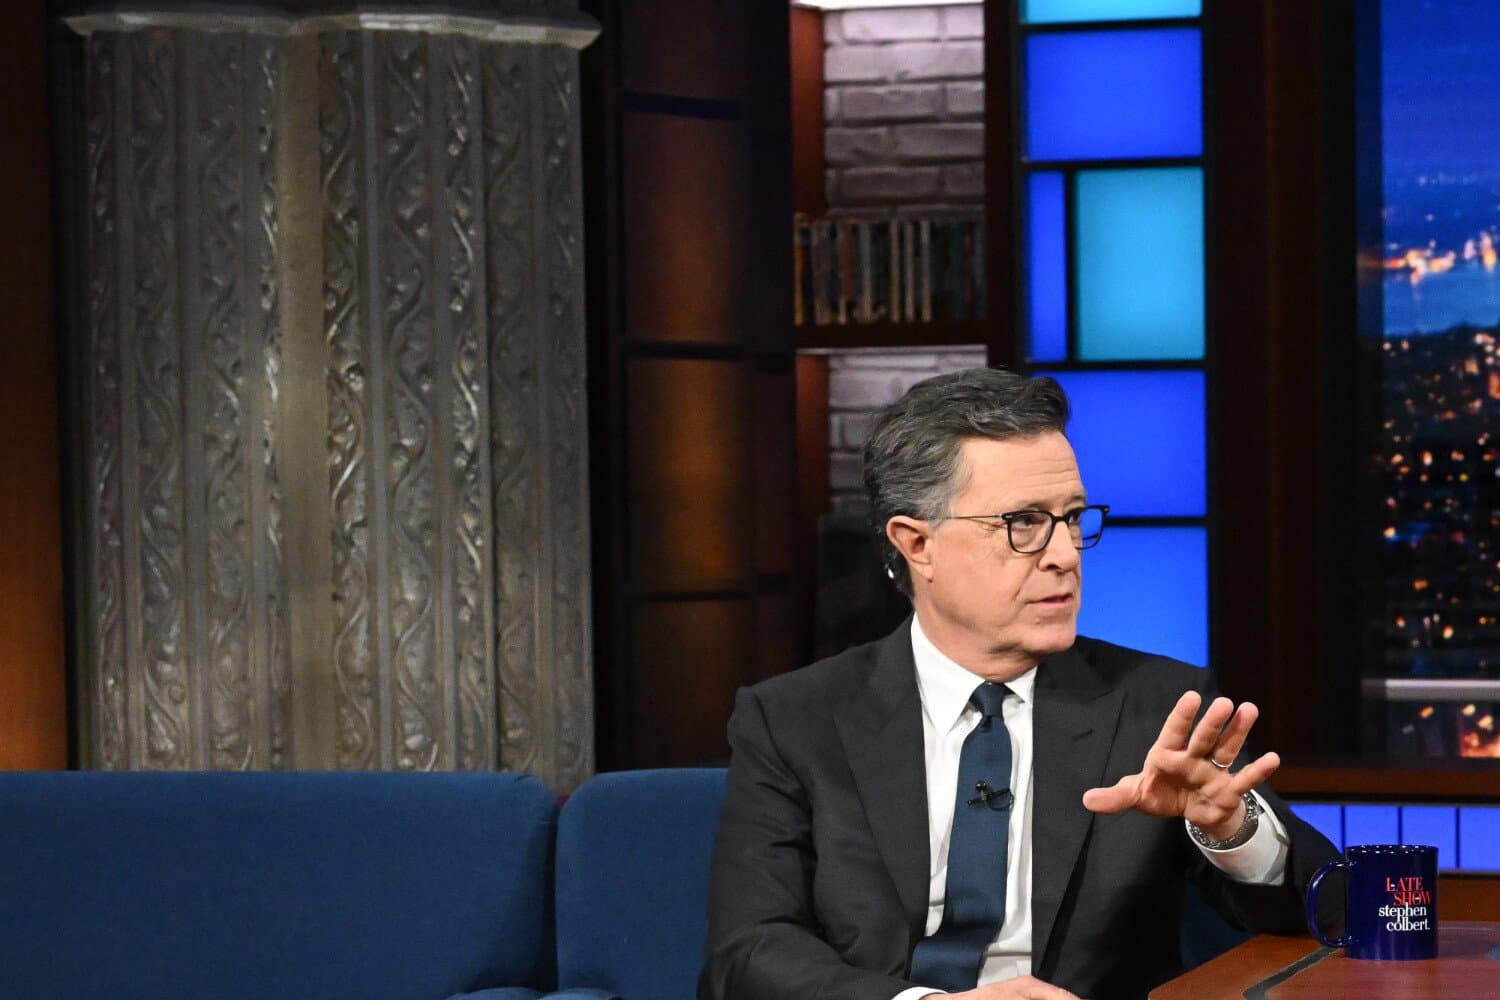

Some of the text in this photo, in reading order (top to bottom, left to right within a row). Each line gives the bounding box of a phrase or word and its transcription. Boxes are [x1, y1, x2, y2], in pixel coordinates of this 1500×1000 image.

[1386, 877, 1423, 891] LATE
[1393, 891, 1430, 905] SHOW
[1378, 901, 1427, 921] stephen
